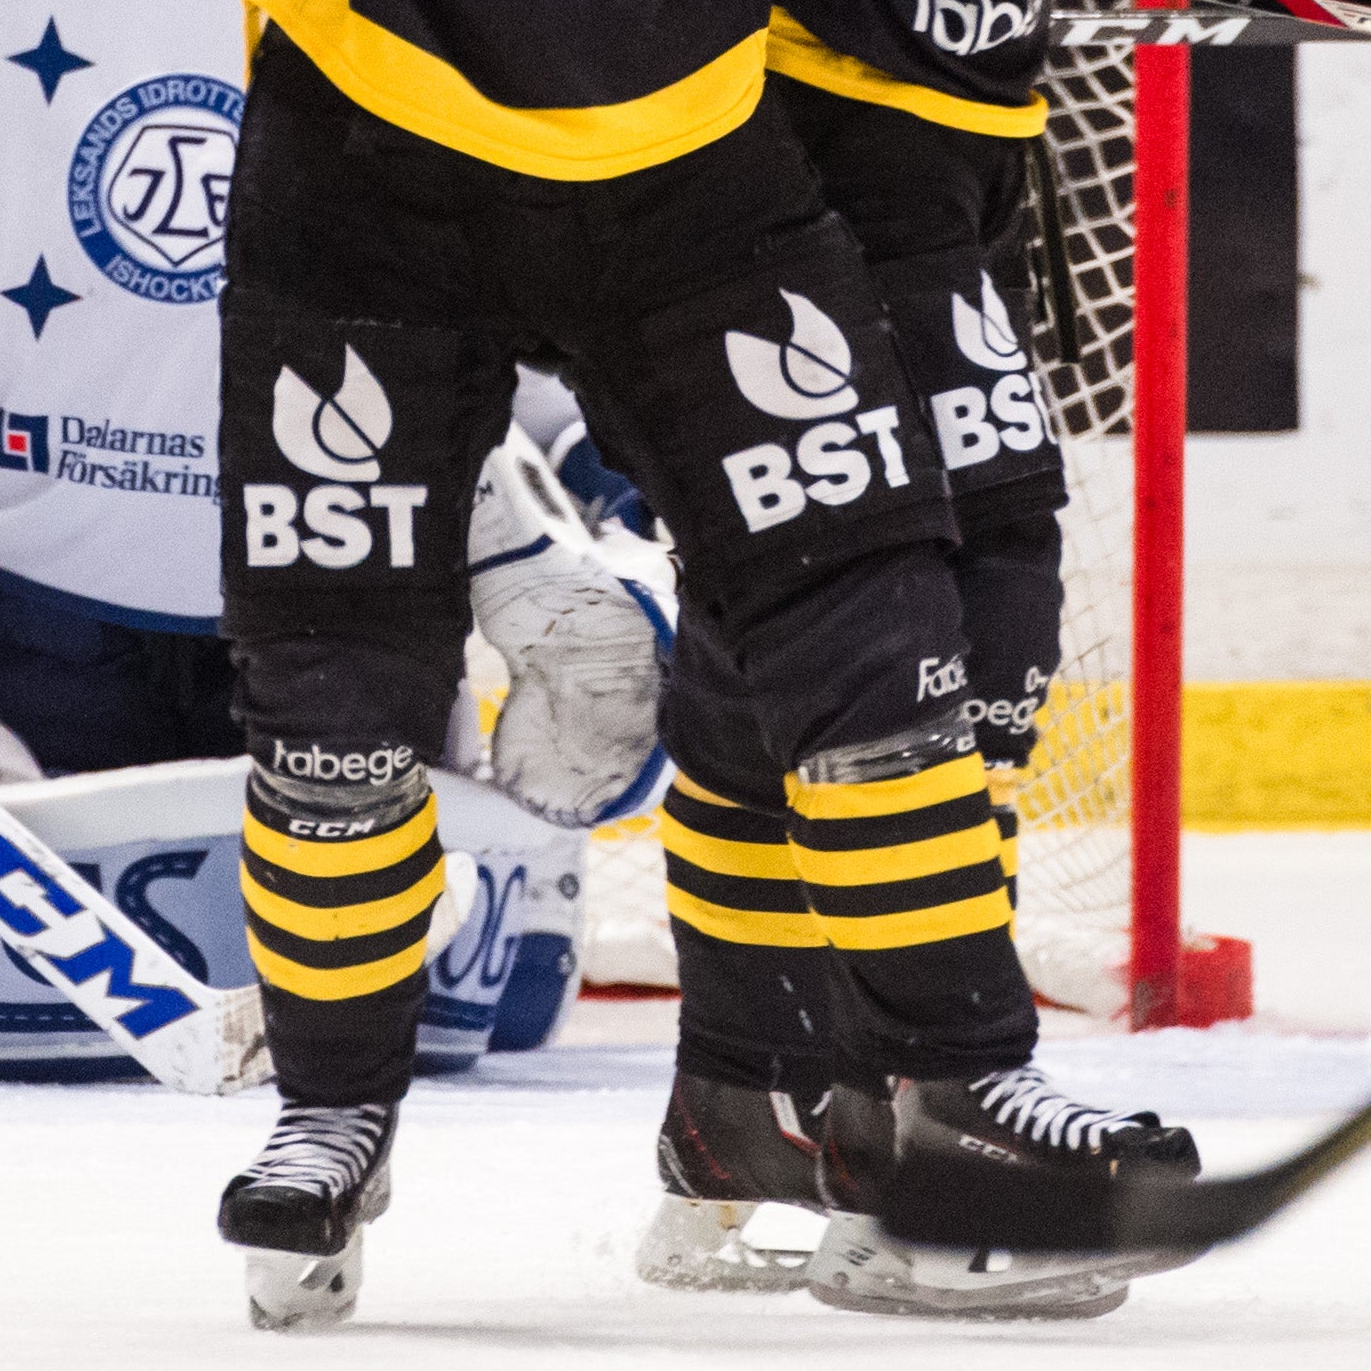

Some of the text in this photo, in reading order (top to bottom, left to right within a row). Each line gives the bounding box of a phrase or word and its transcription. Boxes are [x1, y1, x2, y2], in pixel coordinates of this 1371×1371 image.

[61, 416, 206, 459] Dalarnas
[722, 405, 910, 533] BST
[243, 483, 428, 569] BST
[289, 817, 374, 837] CCM
